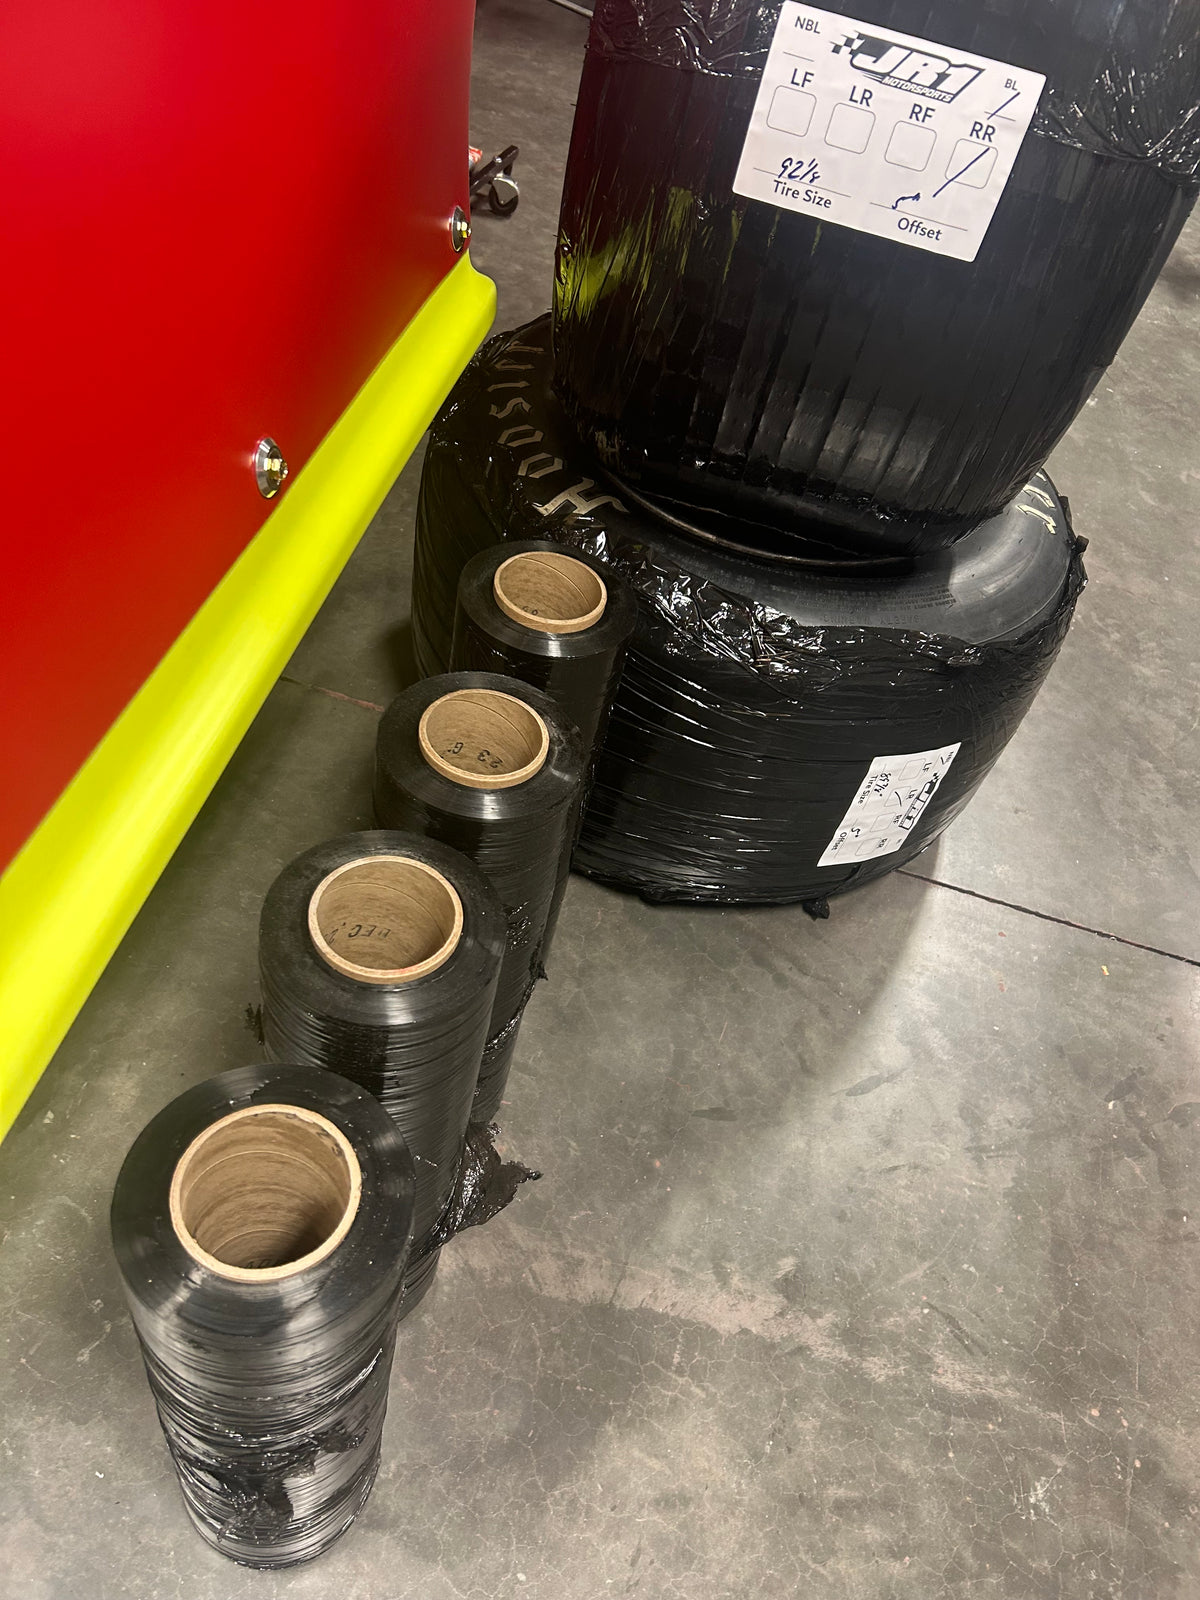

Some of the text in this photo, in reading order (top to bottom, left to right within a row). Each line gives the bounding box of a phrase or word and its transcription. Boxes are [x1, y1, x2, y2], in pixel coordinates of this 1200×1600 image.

[794, 15, 822, 35] NBL
[790, 67, 815, 89] LF
[850, 38, 986, 98] JR1
[849, 85, 874, 108] LR
[881, 75, 955, 103] MOTORSPORTS
[1004, 78, 1019, 92] BL
[909, 103, 936, 124] RF
[969, 120, 997, 143] RR
[773, 179, 832, 209] Tire Size
[897, 217, 943, 242] Offset
[857, 774, 878, 805] Tire Size
